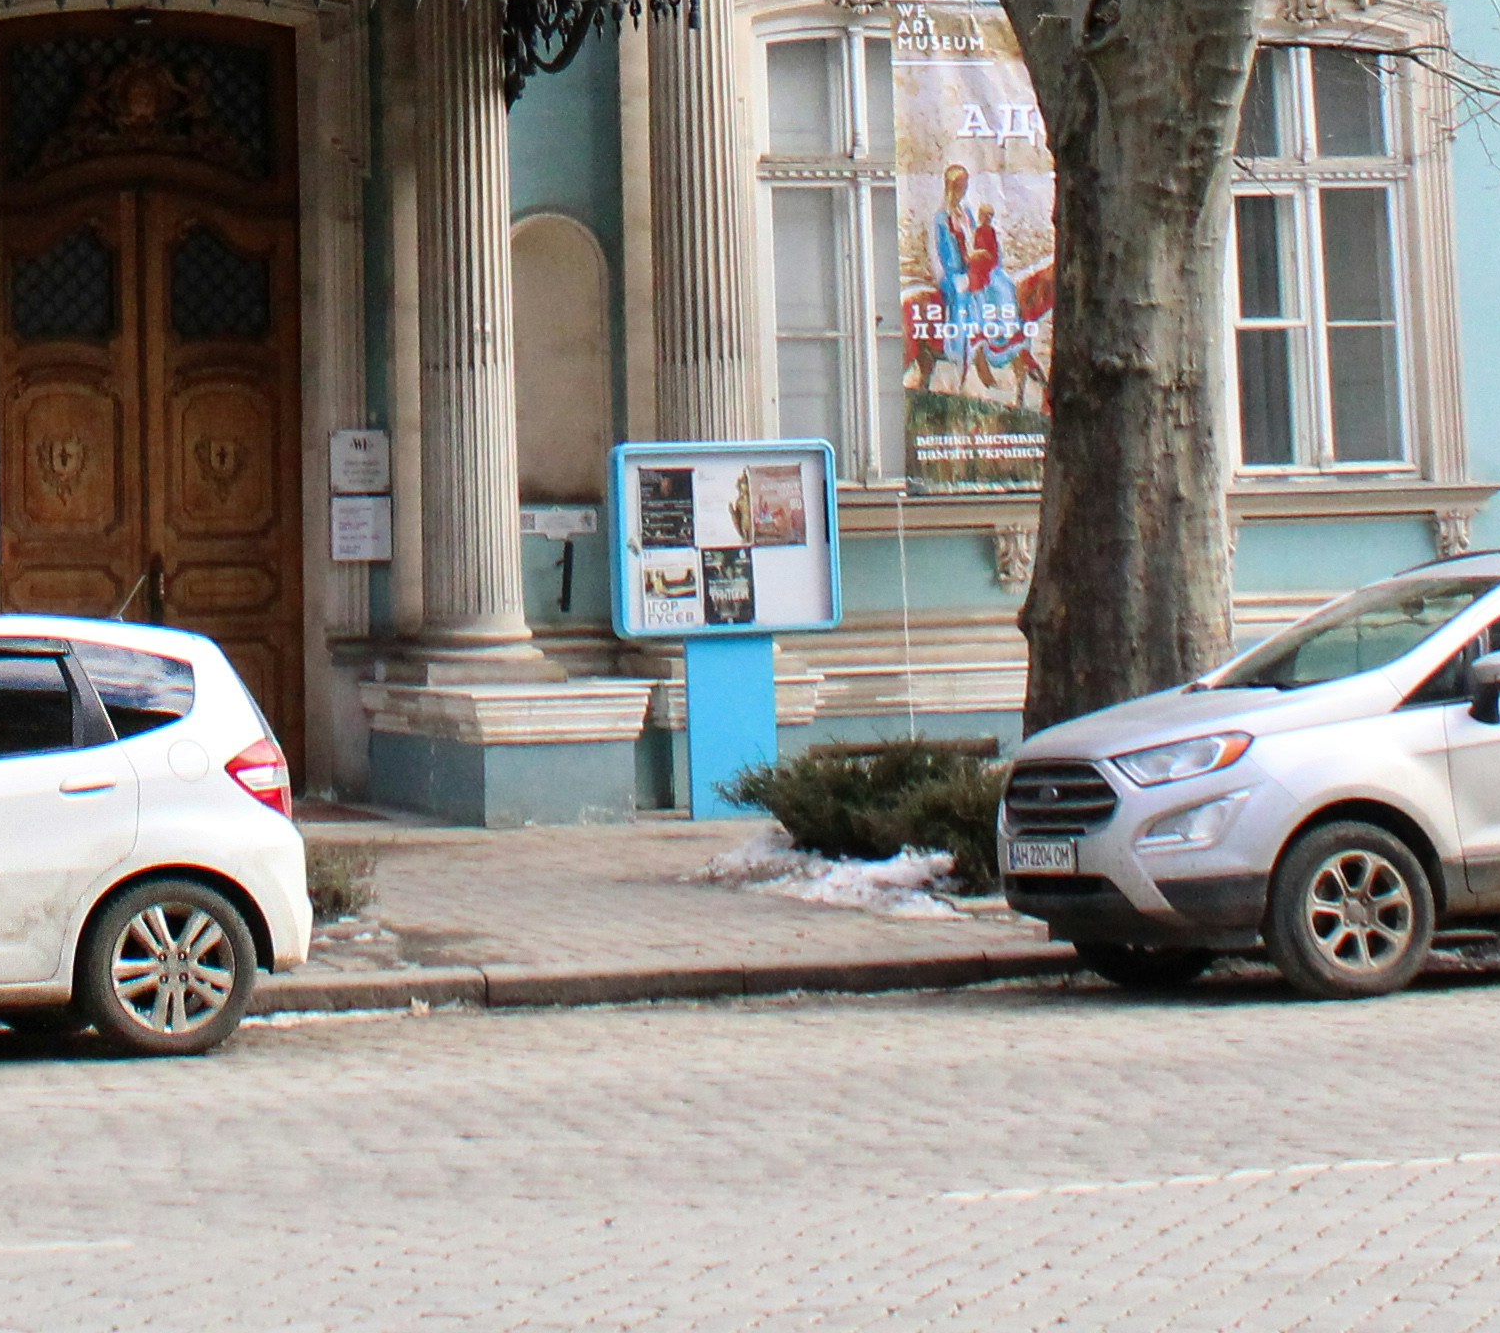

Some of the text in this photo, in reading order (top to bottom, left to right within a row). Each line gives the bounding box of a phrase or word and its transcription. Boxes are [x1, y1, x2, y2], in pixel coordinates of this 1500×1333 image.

[896, 3, 927, 19] WE
[897, 19, 936, 35] ART
[897, 35, 985, 52] MUSEUM
[911, 303, 943, 321] 12
[982, 302, 1017, 320] 28
[911, 320, 1040, 340] ЛЮТОГО
